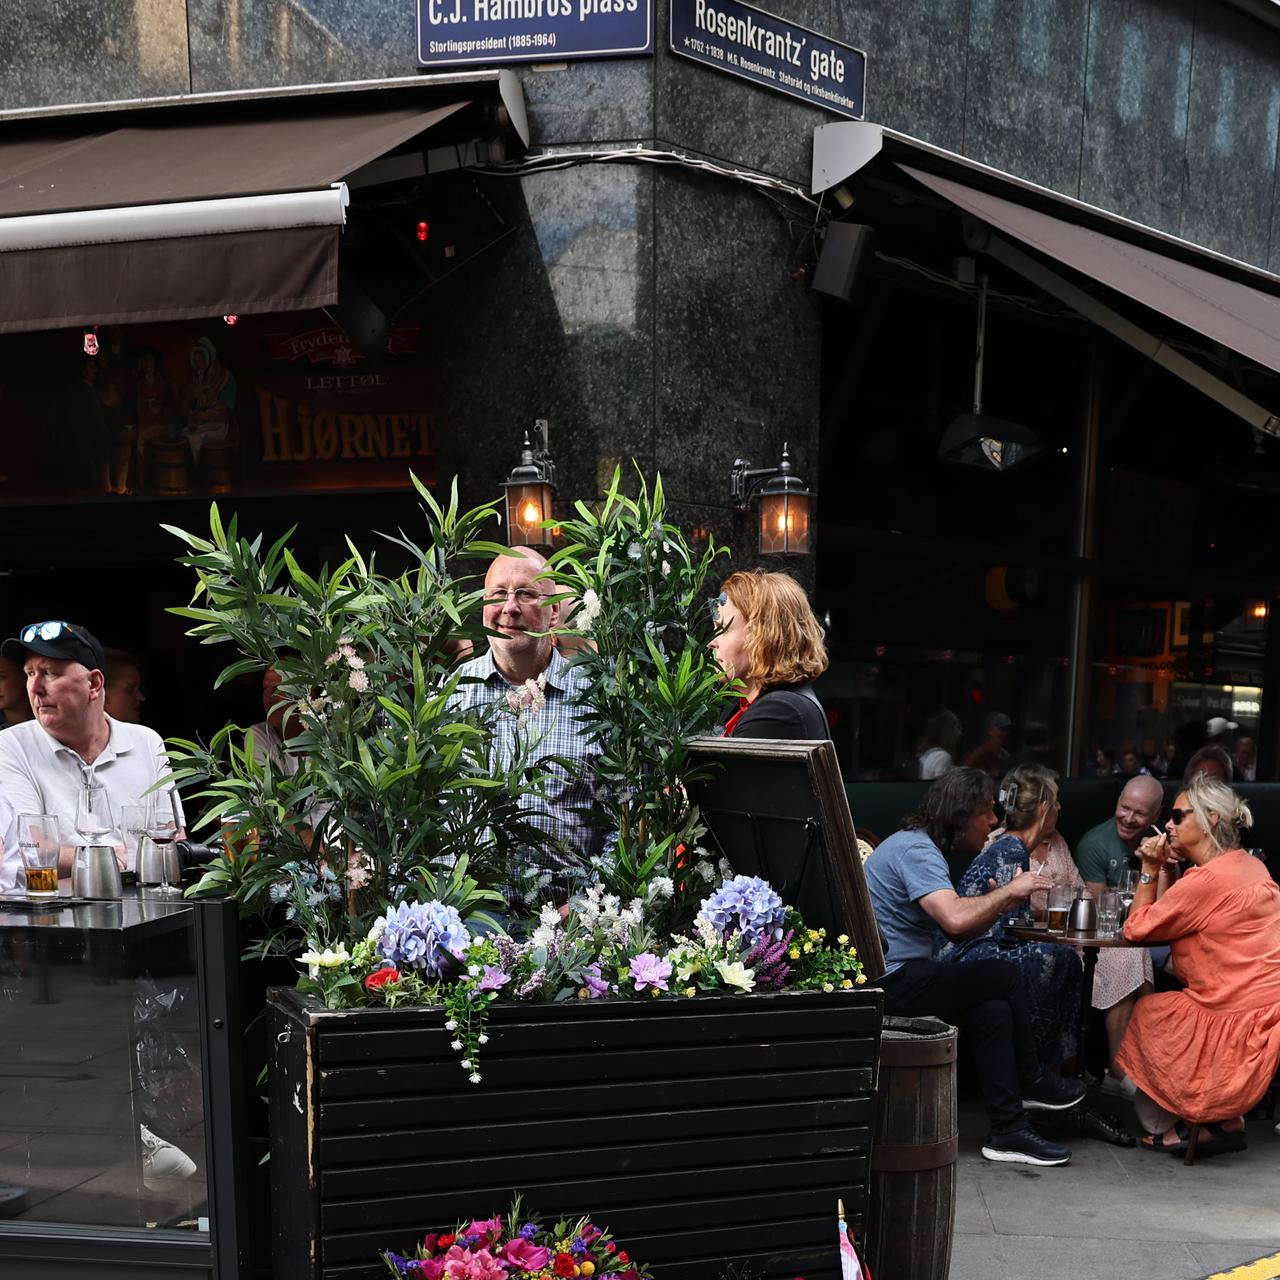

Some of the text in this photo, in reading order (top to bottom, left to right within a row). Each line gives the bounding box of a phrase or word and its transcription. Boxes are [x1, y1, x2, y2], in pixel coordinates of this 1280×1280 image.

[474, 0, 572, 22] Hambros
[429, 32, 557, 53] Stortingspresident (1885-1964)
[810, 48, 845, 83] gate
[305, 373, 388, 390] LETTØL
